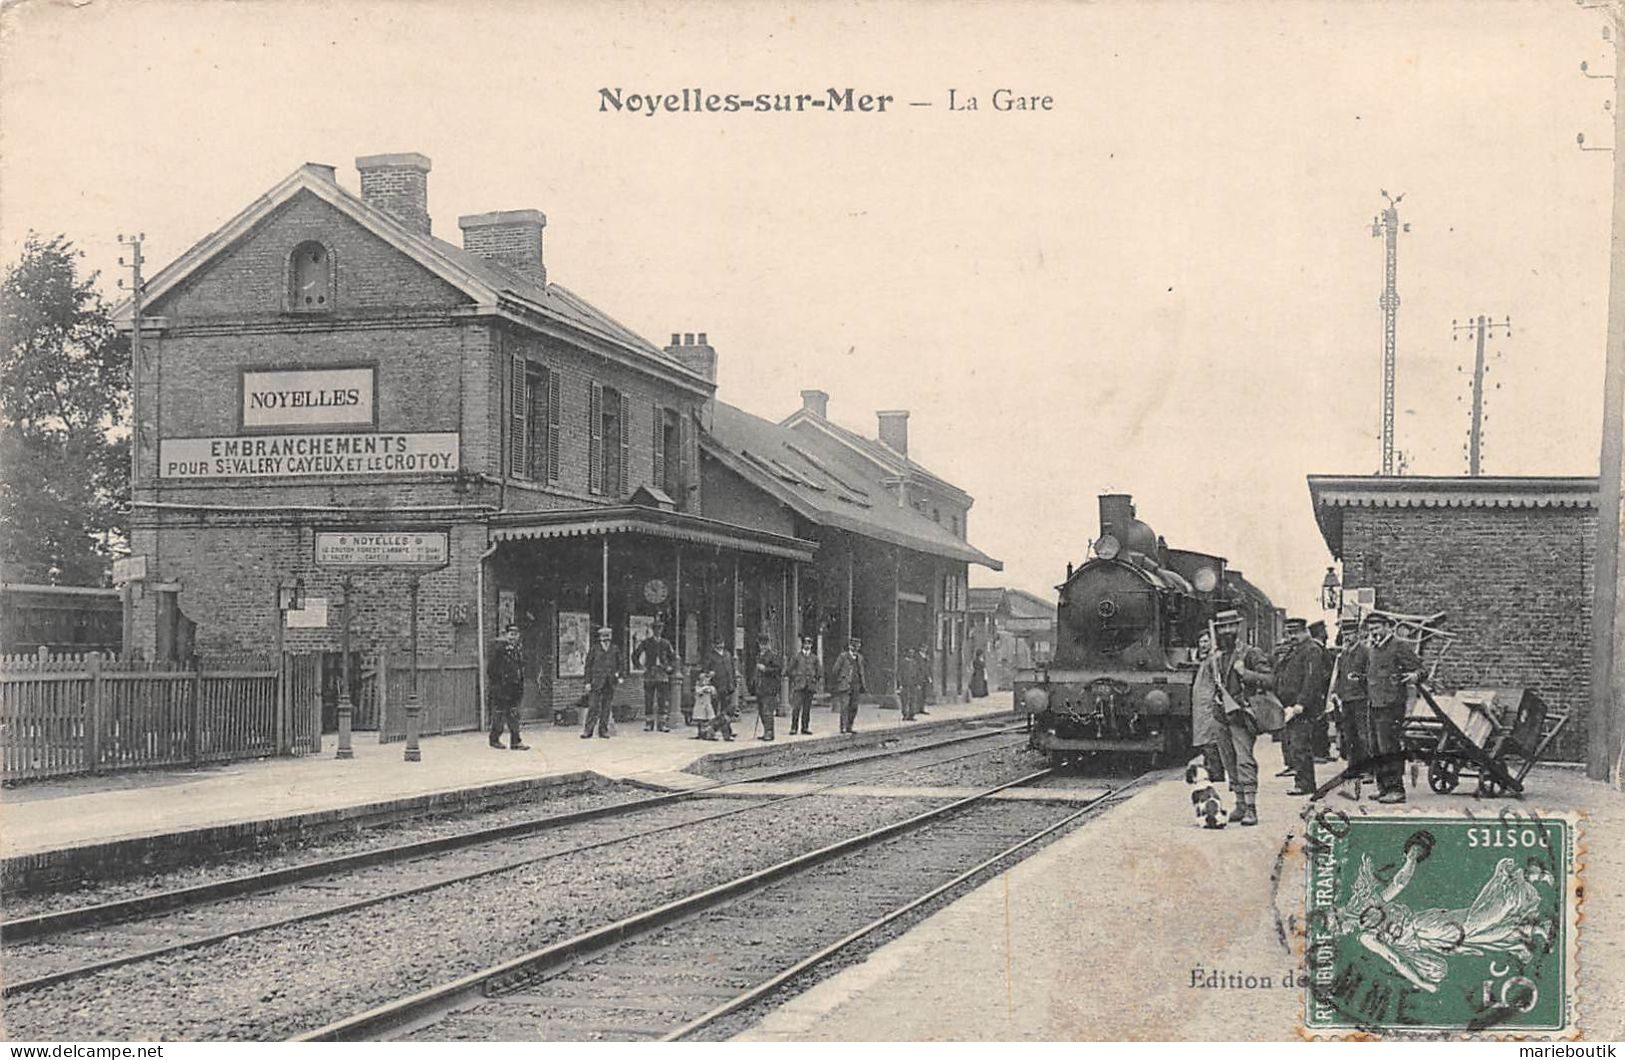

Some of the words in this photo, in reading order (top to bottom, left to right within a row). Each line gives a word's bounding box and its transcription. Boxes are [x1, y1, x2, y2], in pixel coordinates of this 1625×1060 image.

[250, 389, 360, 409] NOYELLES
[211, 436, 407, 457] EMBRANCHEMENTS
[168, 461, 209, 475] POUR
[232, 457, 281, 473] VALERY
[287, 456, 344, 472] CAYEUX
[347, 457, 362, 471] ET
[368, 456, 382, 470] LE
[353, 536, 409, 545] NOYELLES
[1467, 828, 1551, 848] POSTES
